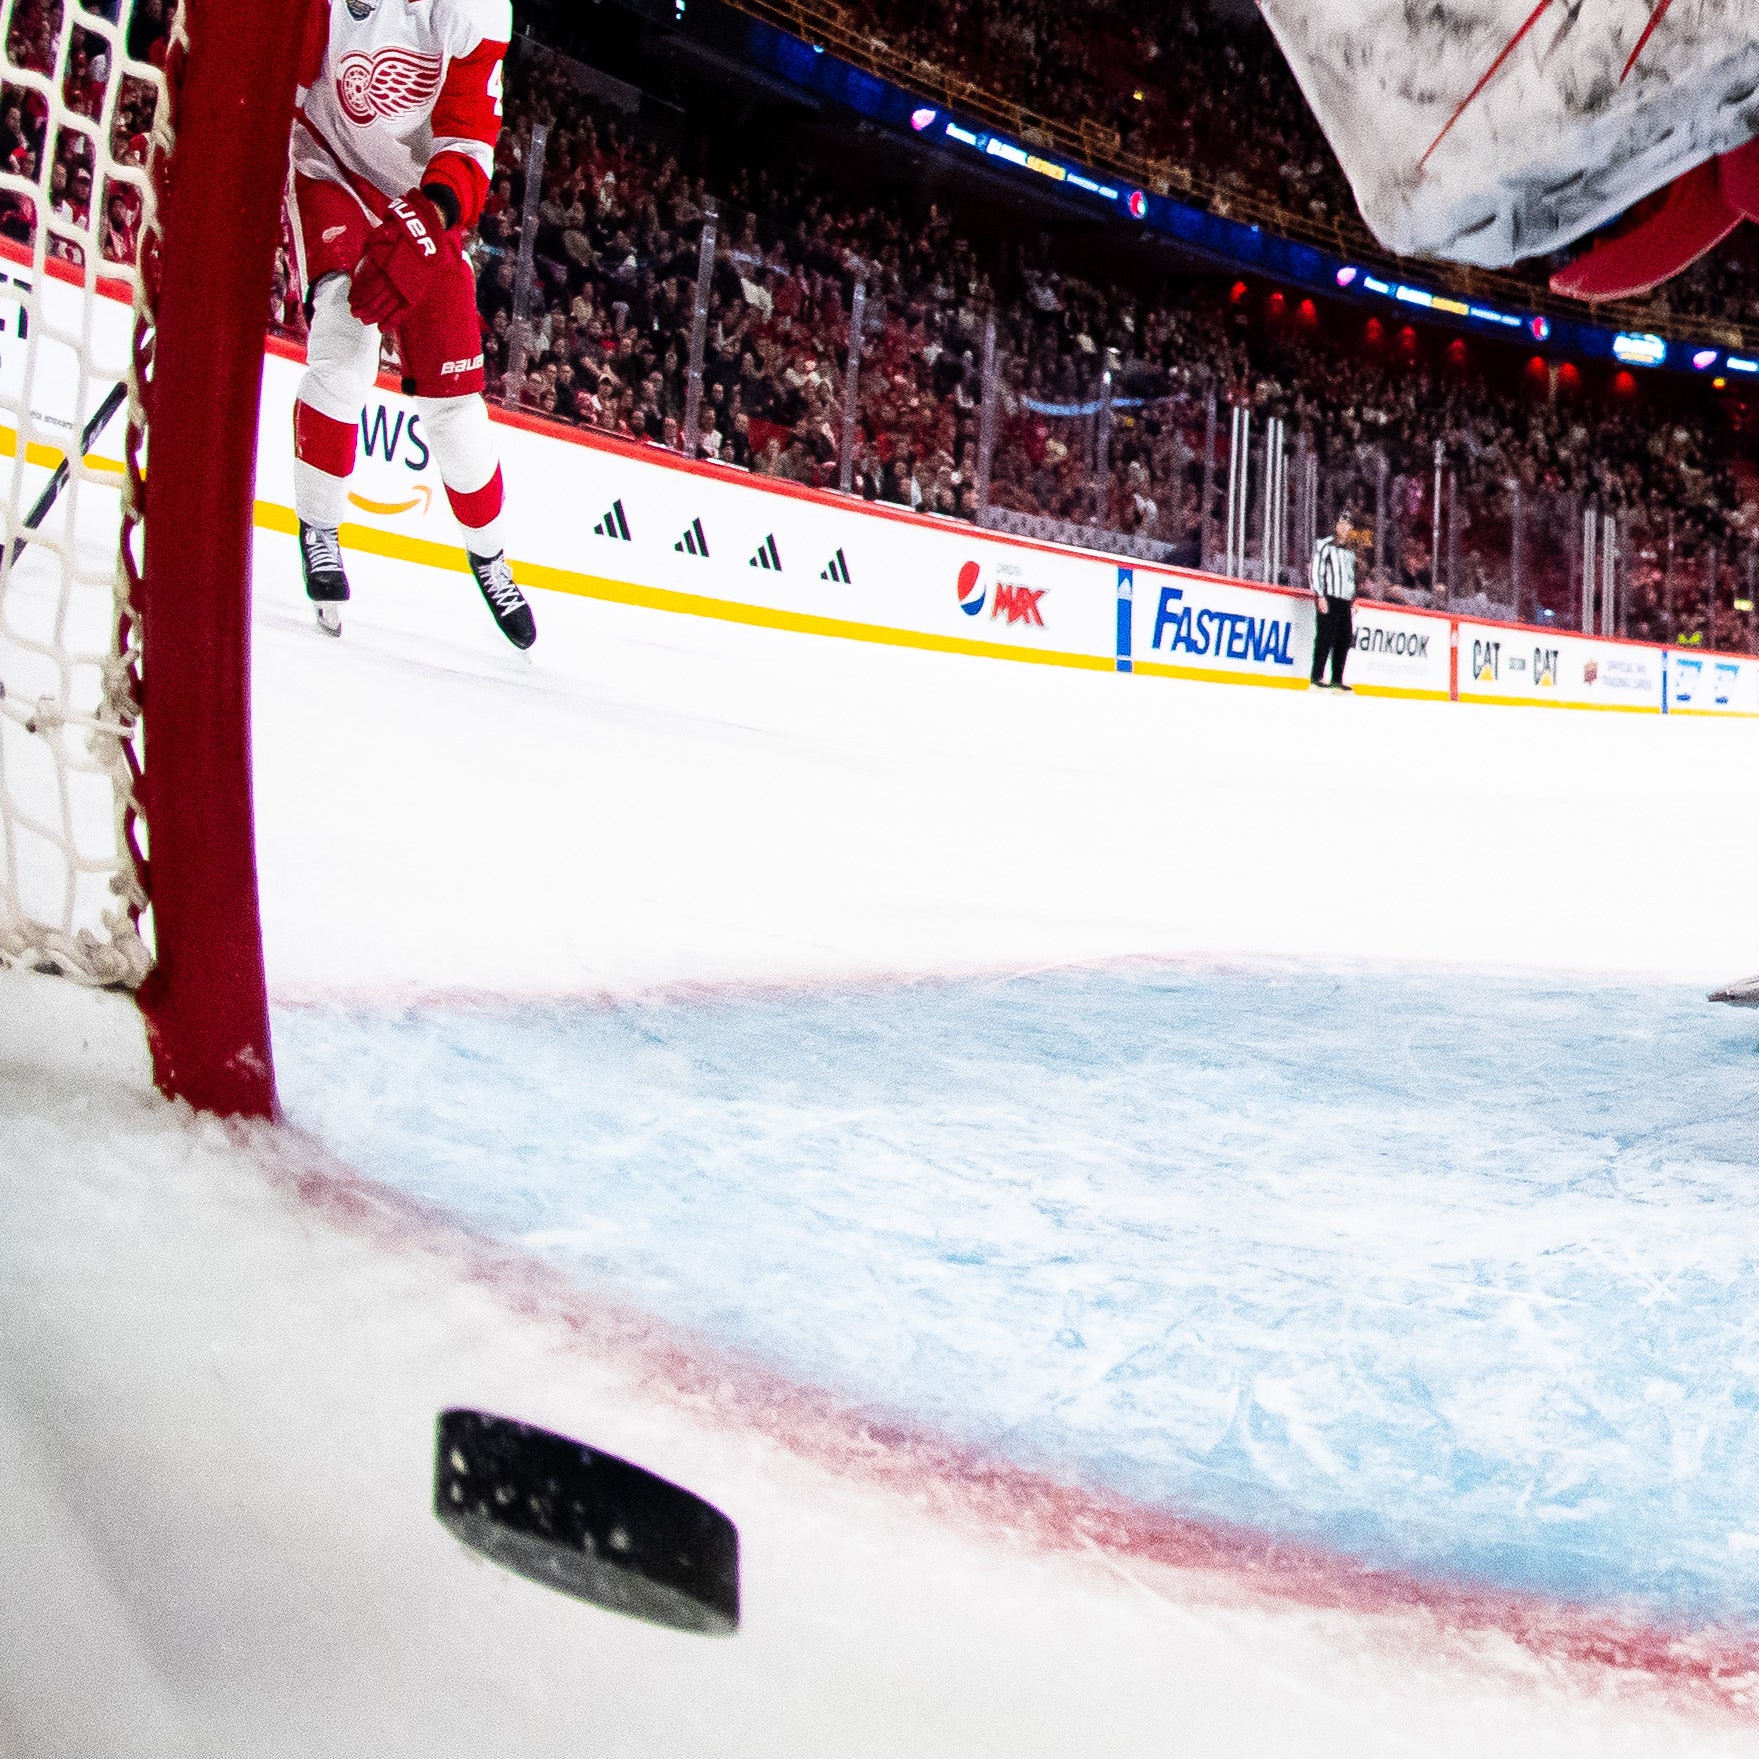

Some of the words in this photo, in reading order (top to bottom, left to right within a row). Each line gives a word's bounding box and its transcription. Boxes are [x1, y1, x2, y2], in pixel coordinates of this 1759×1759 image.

[440, 353, 484, 376] BAUE
[360, 403, 430, 472] WS
[990, 581, 1050, 630] MAX
[1152, 586, 1294, 665] FASTENAL
[1473, 639, 1501, 682] CAT
[1533, 646, 1560, 687] CAT
